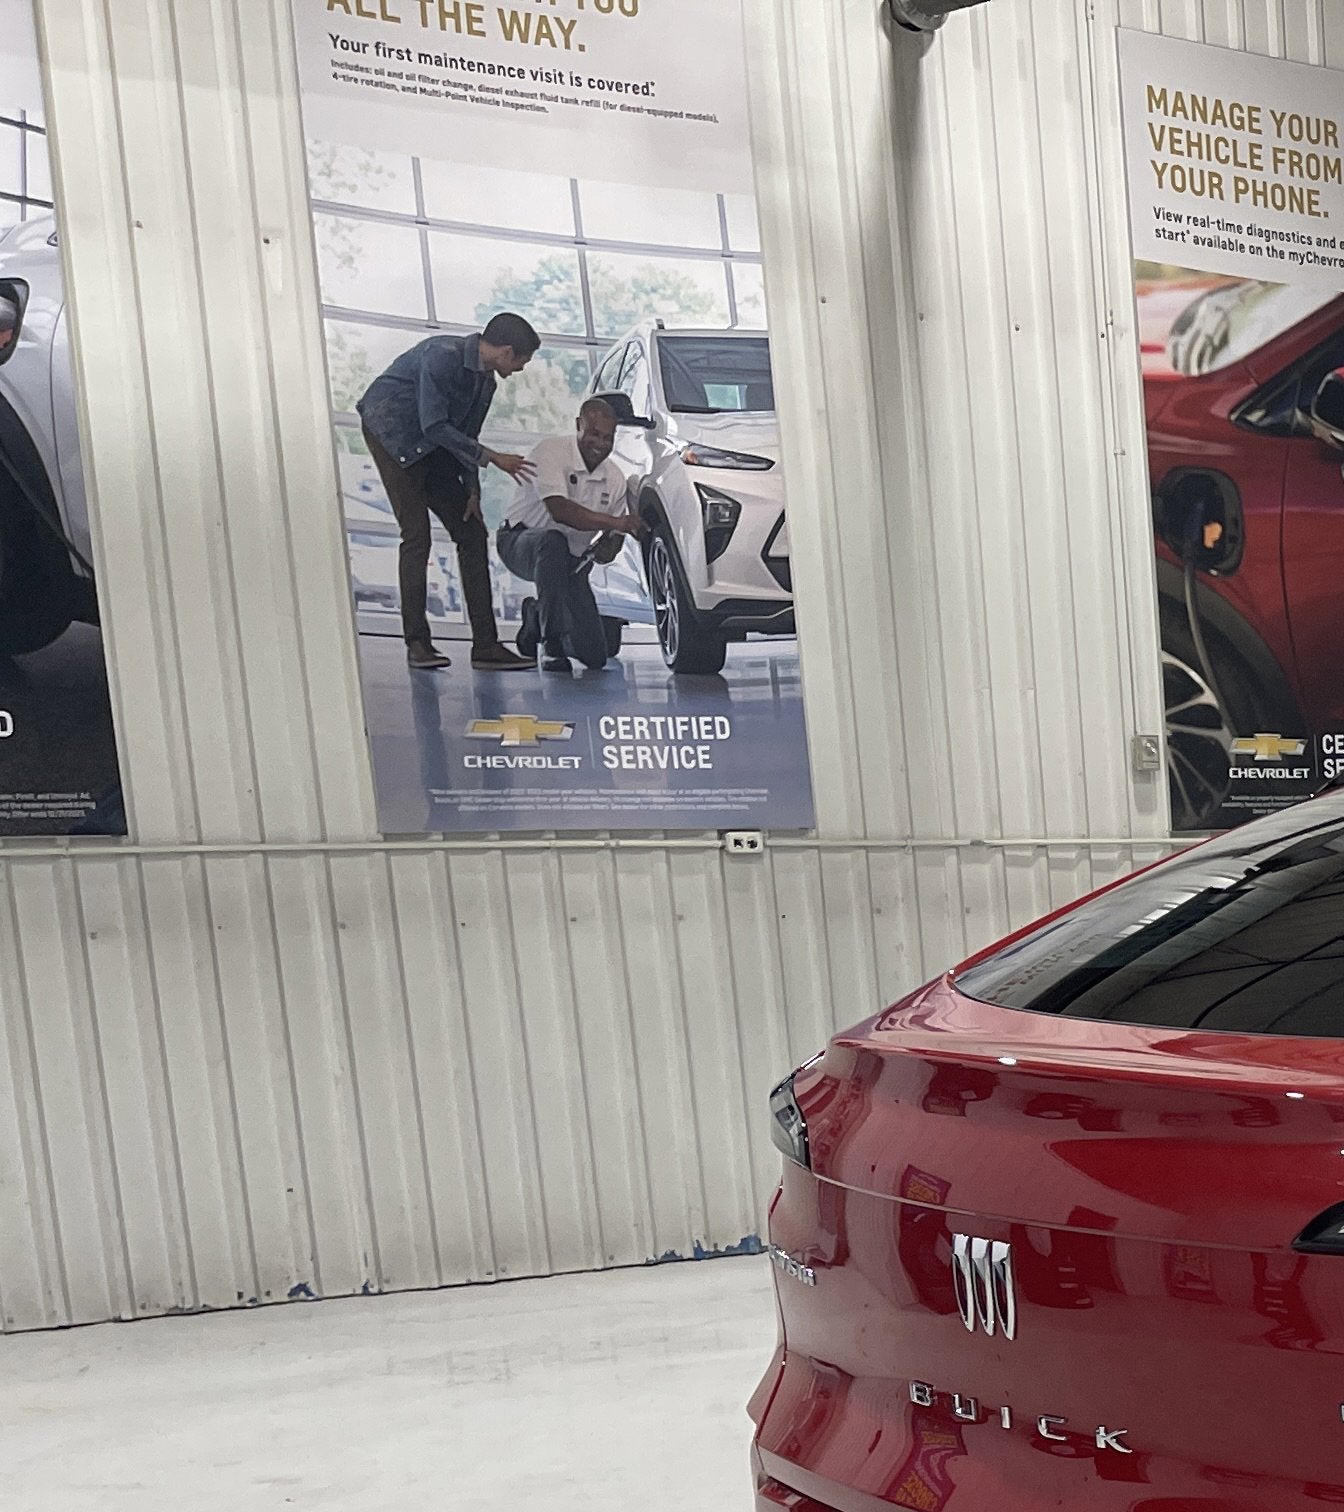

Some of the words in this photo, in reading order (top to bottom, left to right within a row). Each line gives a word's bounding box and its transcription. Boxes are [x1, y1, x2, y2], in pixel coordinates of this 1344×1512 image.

[414, 0, 486, 38] THE
[496, 8, 586, 52] WAY.
[328, 32, 369, 54] Your
[374, 41, 413, 62] first
[418, 52, 526, 79] maintenance
[530, 67, 565, 85] visit
[569, 71, 582, 88] is
[387, 70, 403, 79] and
[401, 85, 417, 94] and
[1146, 84, 1263, 135] MANAGE
[1269, 109, 1339, 148] YOUR
[1148, 122, 1264, 171] VEHICLE
[1272, 147, 1342, 184] FROM
[1150, 159, 1224, 200] YOUR
[1234, 176, 1330, 218] PHONE.
[1153, 206, 1183, 223] View
[1187, 215, 1243, 234] real-time
[1247, 224, 1312, 245] diagnostics
[1316, 236, 1335, 248] and
[1193, 235, 1245, 253] available
[1249, 245, 1263, 256] on
[1266, 245, 1284, 259] the
[600, 715, 731, 740] CERTIFIED
[463, 755, 582, 769] CHEVROLET
[603, 745, 713, 769] SERVICE
[1229, 767, 1310, 779] CHEVROLET
[908, 1380, 1132, 1453] BUICK
